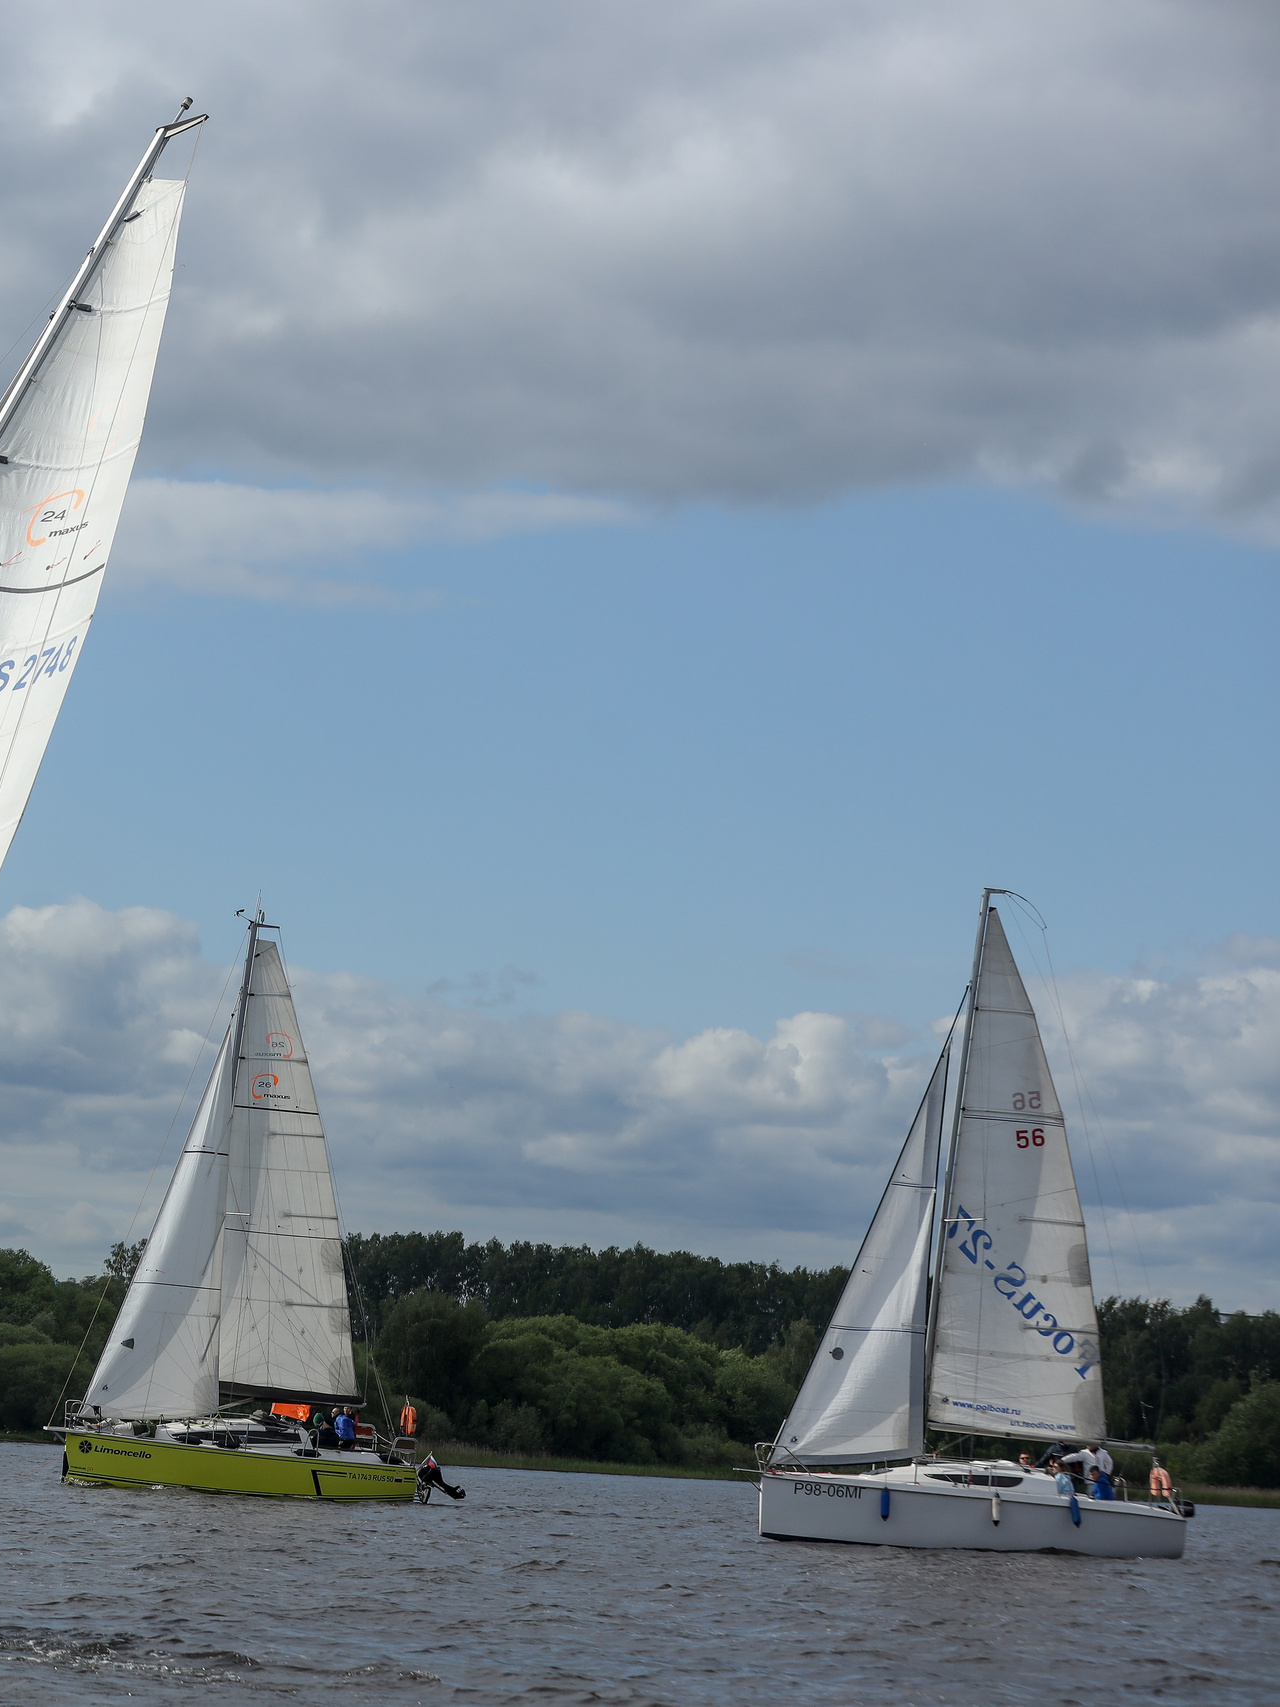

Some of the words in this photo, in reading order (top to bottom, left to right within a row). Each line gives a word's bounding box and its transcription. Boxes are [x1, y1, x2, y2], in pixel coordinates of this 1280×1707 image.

[39, 508, 67, 523] 24
[48, 520, 89, 538] maxus
[258, 1081, 272, 1089] 26
[1015, 1127, 1046, 1149] 56
[952, 1399, 1022, 1416] www.polboat.ru
[94, 1445, 153, 1460] Limoncello
